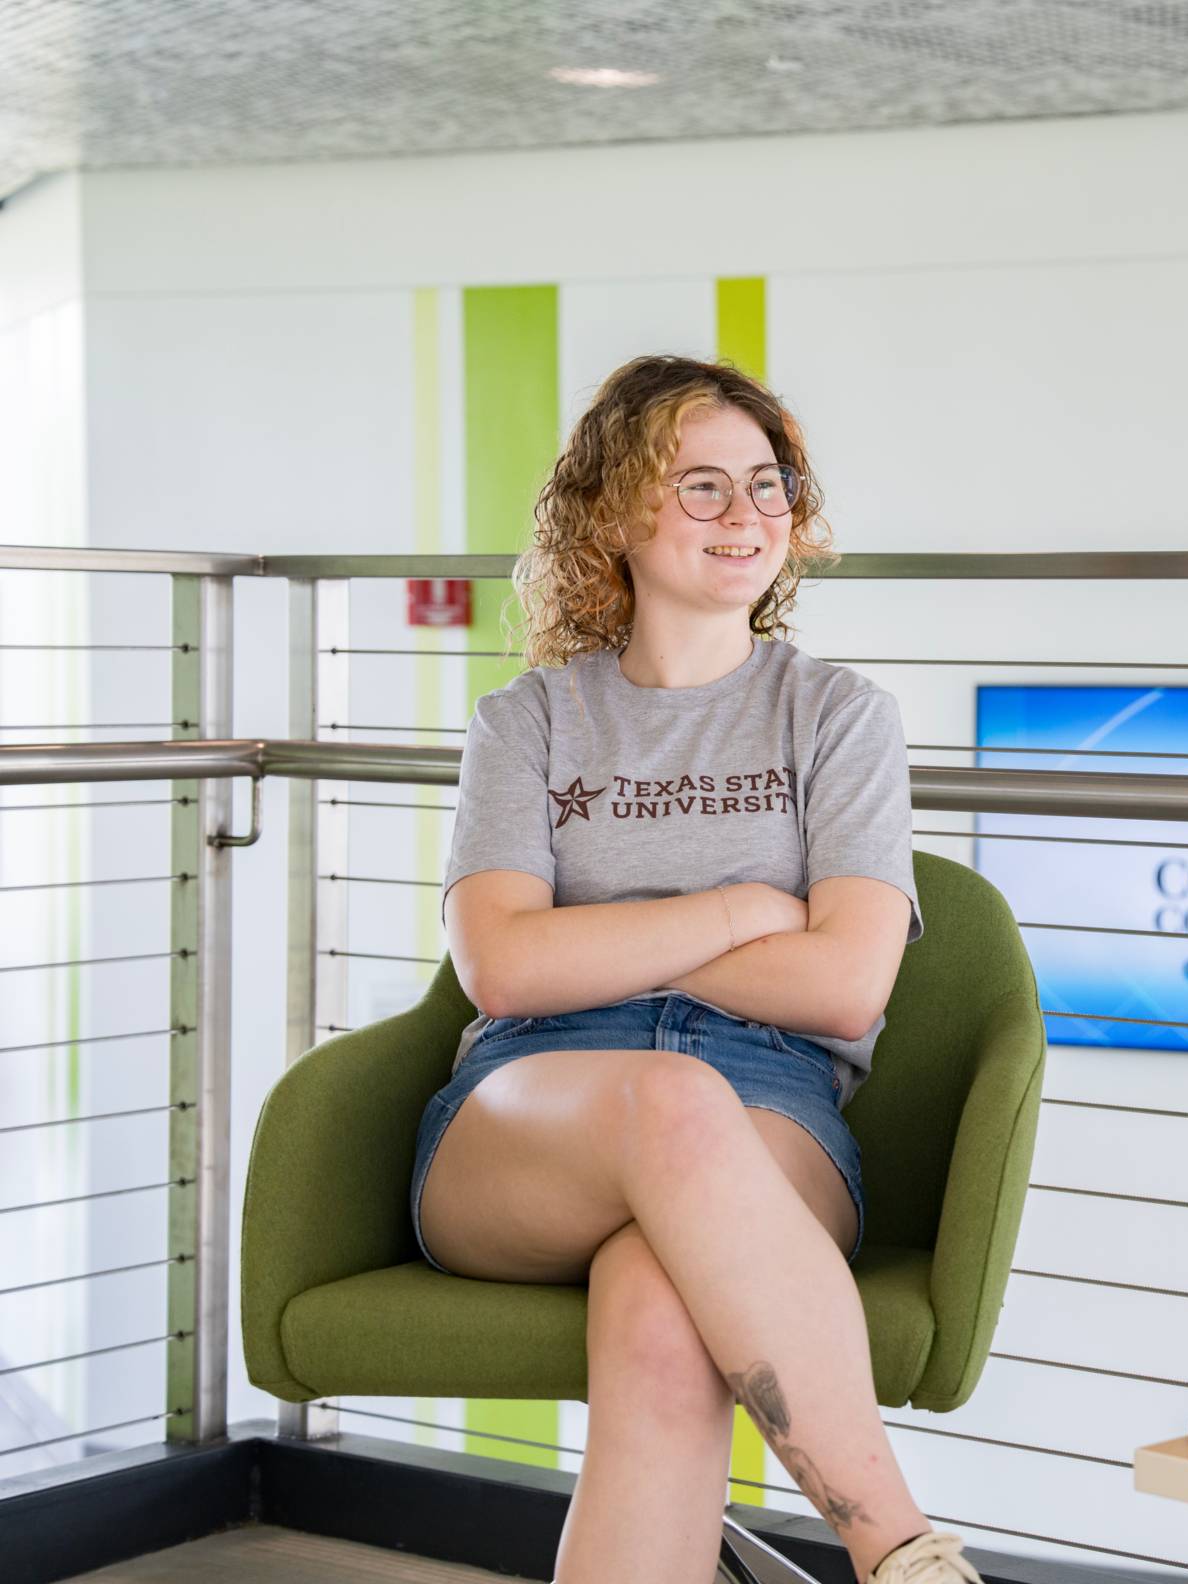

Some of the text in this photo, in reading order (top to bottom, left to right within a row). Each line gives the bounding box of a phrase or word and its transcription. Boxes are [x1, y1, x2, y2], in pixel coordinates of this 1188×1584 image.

[613, 766, 797, 798] TEXAS STAT
[611, 792, 793, 819] UNIVERSIT
